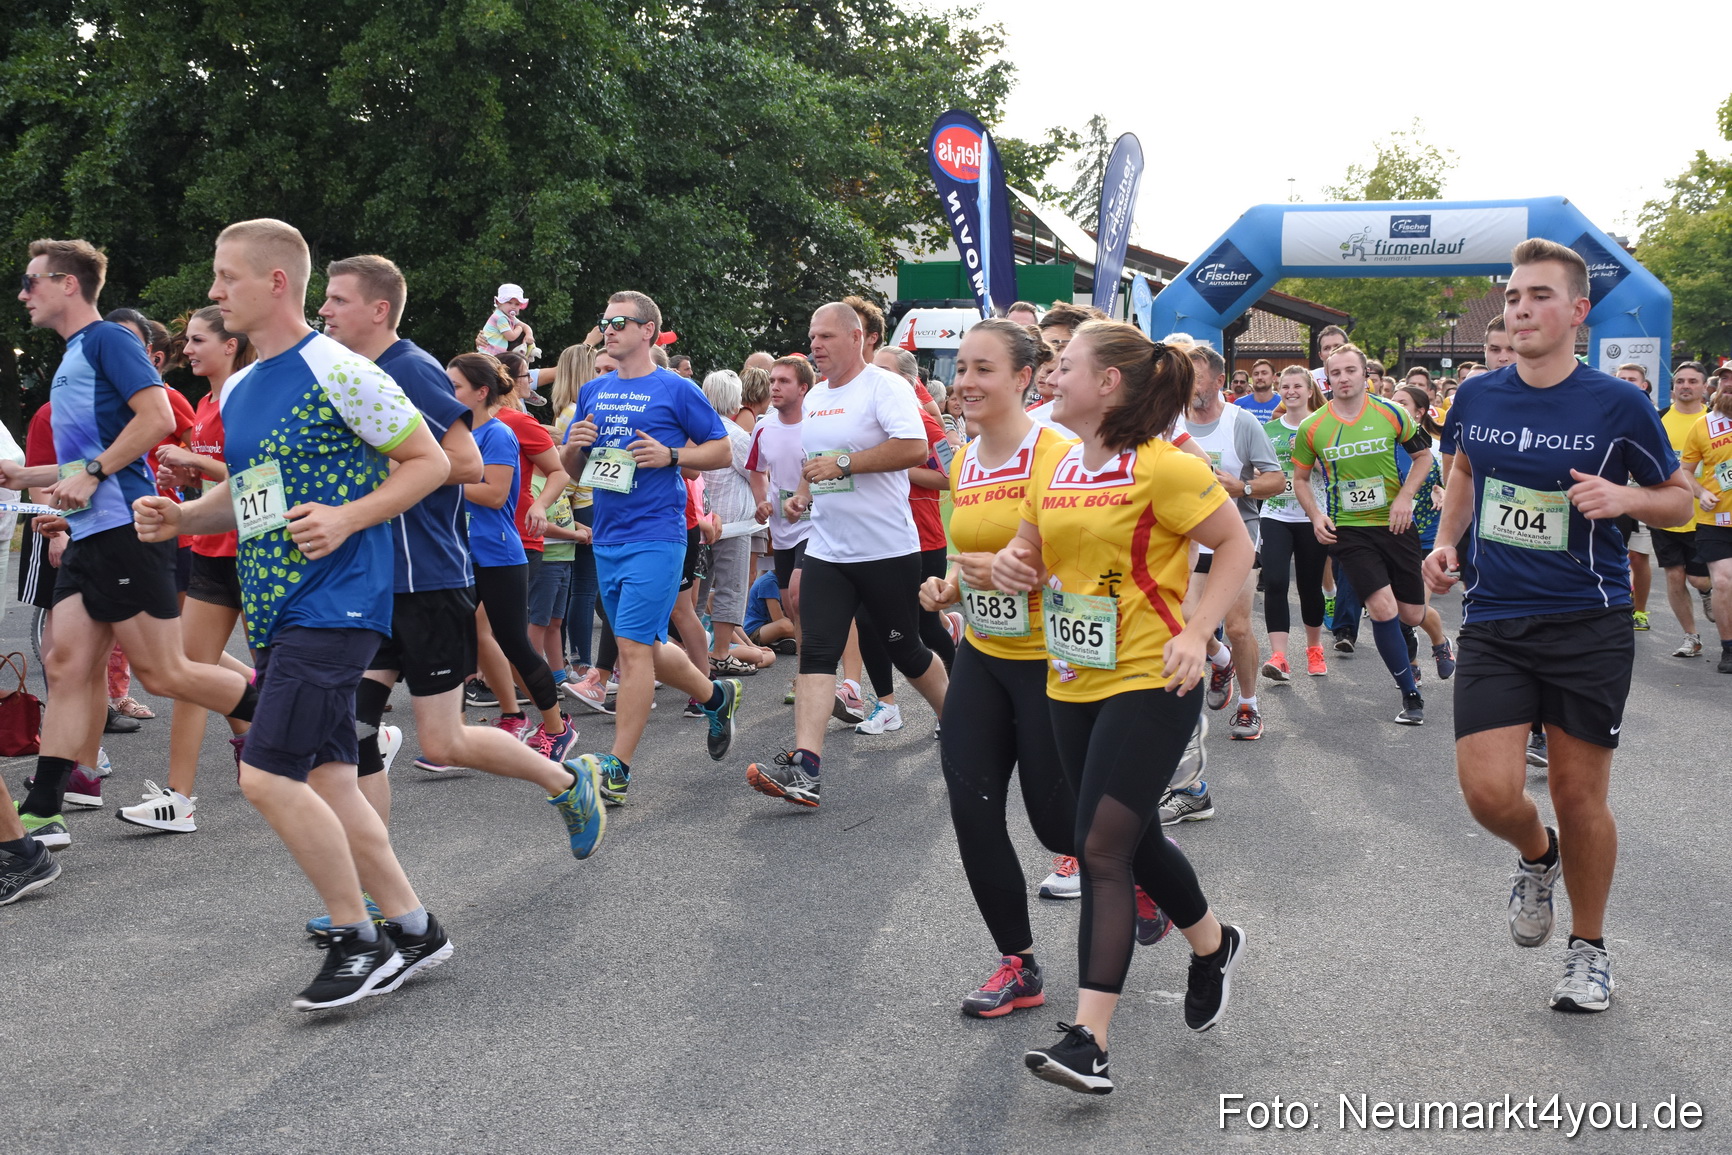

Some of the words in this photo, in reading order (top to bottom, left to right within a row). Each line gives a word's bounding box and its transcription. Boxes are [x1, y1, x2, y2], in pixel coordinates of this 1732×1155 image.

[1398, 222, 1429, 230] Fischer
[1374, 238, 1466, 255] firmenlauf
[1205, 271, 1251, 281] Fischer
[597, 391, 619, 400] Wenn
[629, 391, 651, 402] beim
[595, 402, 646, 413] Hausverkauf
[817, 408, 846, 417] KLEBL
[605, 414, 628, 424] richtig
[600, 426, 633, 436] LAUFEN
[1469, 425, 1516, 445] EURO
[1535, 434, 1596, 451] POLES
[1323, 437, 1389, 461] BOCK
[592, 461, 621, 479] 722
[955, 493, 981, 508] MAX
[984, 486, 1025, 503] BÖGL
[1041, 496, 1080, 510] MAX
[1083, 491, 1134, 508] BÖGL
[1349, 489, 1376, 503] 324
[240, 489, 268, 520] 217
[1499, 504, 1547, 533] 704
[1517, 532, 1552, 541] Alexander
[967, 593, 1017, 619] 1583
[1050, 613, 1103, 647] 1665
[1070, 645, 1099, 656] Christina
